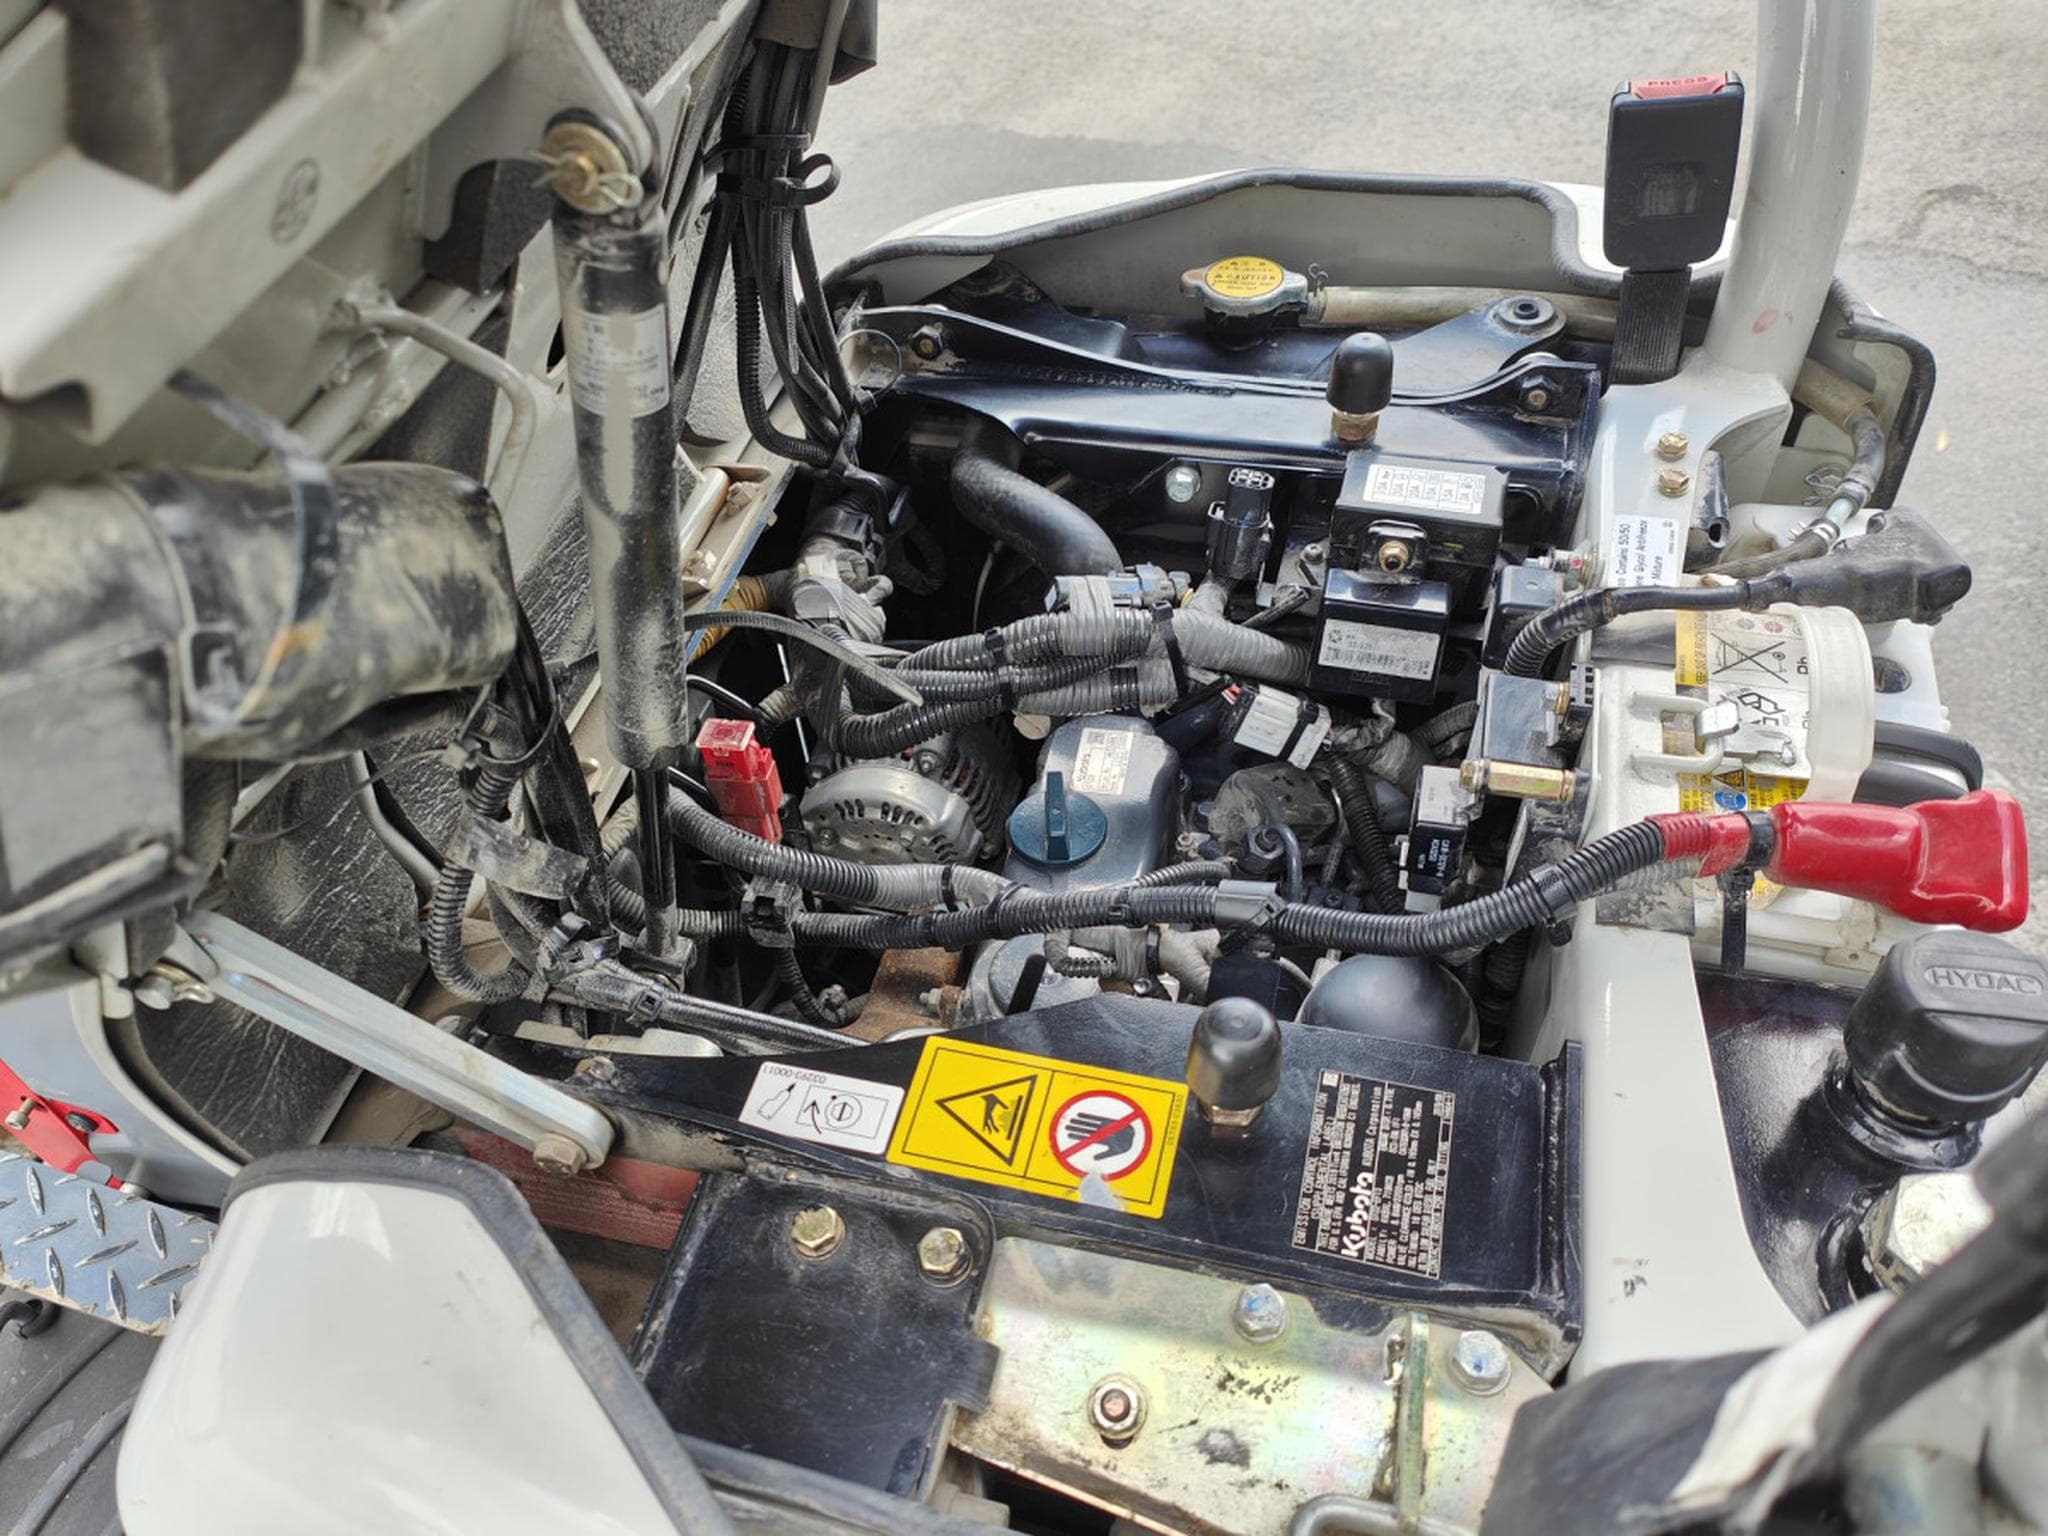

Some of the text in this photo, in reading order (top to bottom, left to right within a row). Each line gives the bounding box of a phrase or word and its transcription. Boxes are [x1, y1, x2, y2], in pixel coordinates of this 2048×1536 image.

[1617, 523, 1630, 545] 50/50
[1931, 968, 2038, 995] HYDAC
[1294, 1092, 1328, 1244] EMISSION CONTROL INFORMATION
[1311, 1151, 1329, 1219] (SUPPLEMENTAL
[1341, 1171, 1374, 1257] Kubota
[1366, 1086, 1382, 1136] Corporation
